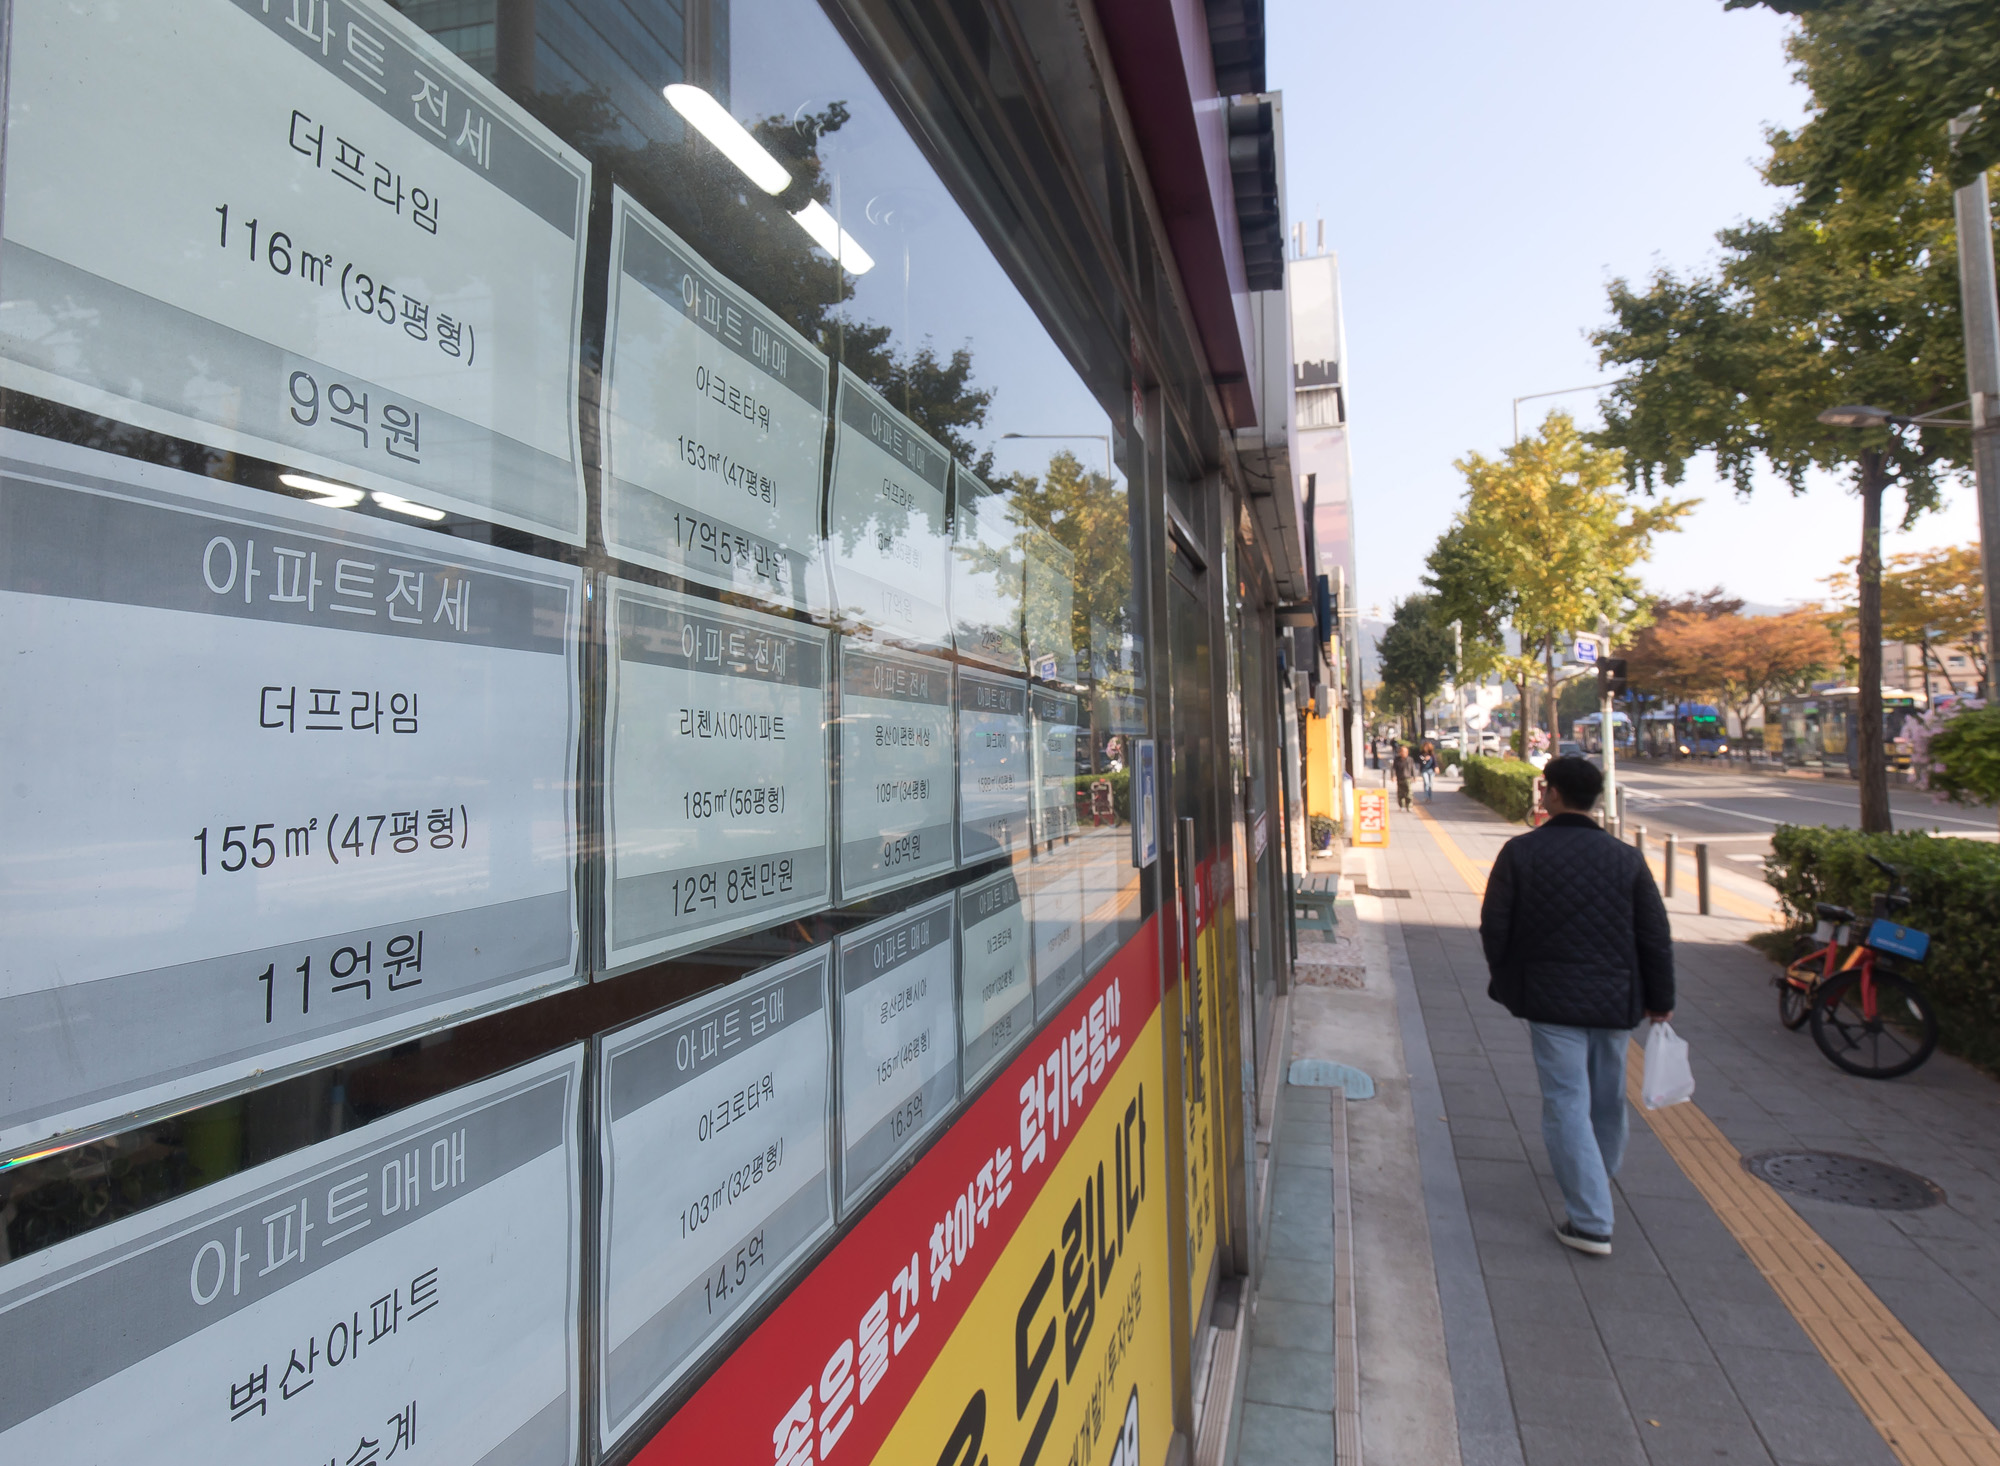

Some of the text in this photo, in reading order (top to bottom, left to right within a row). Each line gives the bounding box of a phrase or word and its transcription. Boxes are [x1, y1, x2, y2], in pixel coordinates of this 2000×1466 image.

[262, 0, 491, 170] 파트 전세
[288, 109, 439, 235] 더프라임
[682, 273, 787, 378] 아파트 매매
[289, 370, 422, 465] 9억원
[696, 365, 770, 433] 아크로타워
[871, 412, 926, 474] 아파트 매매
[882, 478, 915, 512] 더프라임
[674, 513, 788, 584] 17억5천만원
[203, 535, 471, 633] 아파트전세
[682, 624, 786, 677] 아파트 전세
[873, 665, 929, 698] 아파트 전세
[259, 686, 418, 734] 더프라임
[680, 709, 786, 741] 리첸시아아파트
[875, 725, 930, 747] 용산이편한세상
[884, 834, 921, 867] 9.5억원
[672, 858, 793, 916] 12억 8천만원
[258, 930, 424, 1022] 11억원
[873, 919, 930, 969] 아파트 매매
[676, 987, 784, 1071] 아파트 급매
[880, 977, 927, 1025] 용산리첸시아
[699, 1072, 774, 1141] 아크로타워
[890, 1092, 923, 1143] 16.5억
[190, 1128, 466, 1305] 아파트매매
[773, 1252, 919, 1466] 좋은물건
[929, 1146, 1012, 1302] 찾아주는
[1020, 977, 1120, 1174] 럭키부동산
[705, 1230, 764, 1314] 14.5억
[1015, 1082, 1146, 1466] 드립니다
[229, 1267, 439, 1421] 벽산아파트
[323, 1400, 417, 1466] 승계
